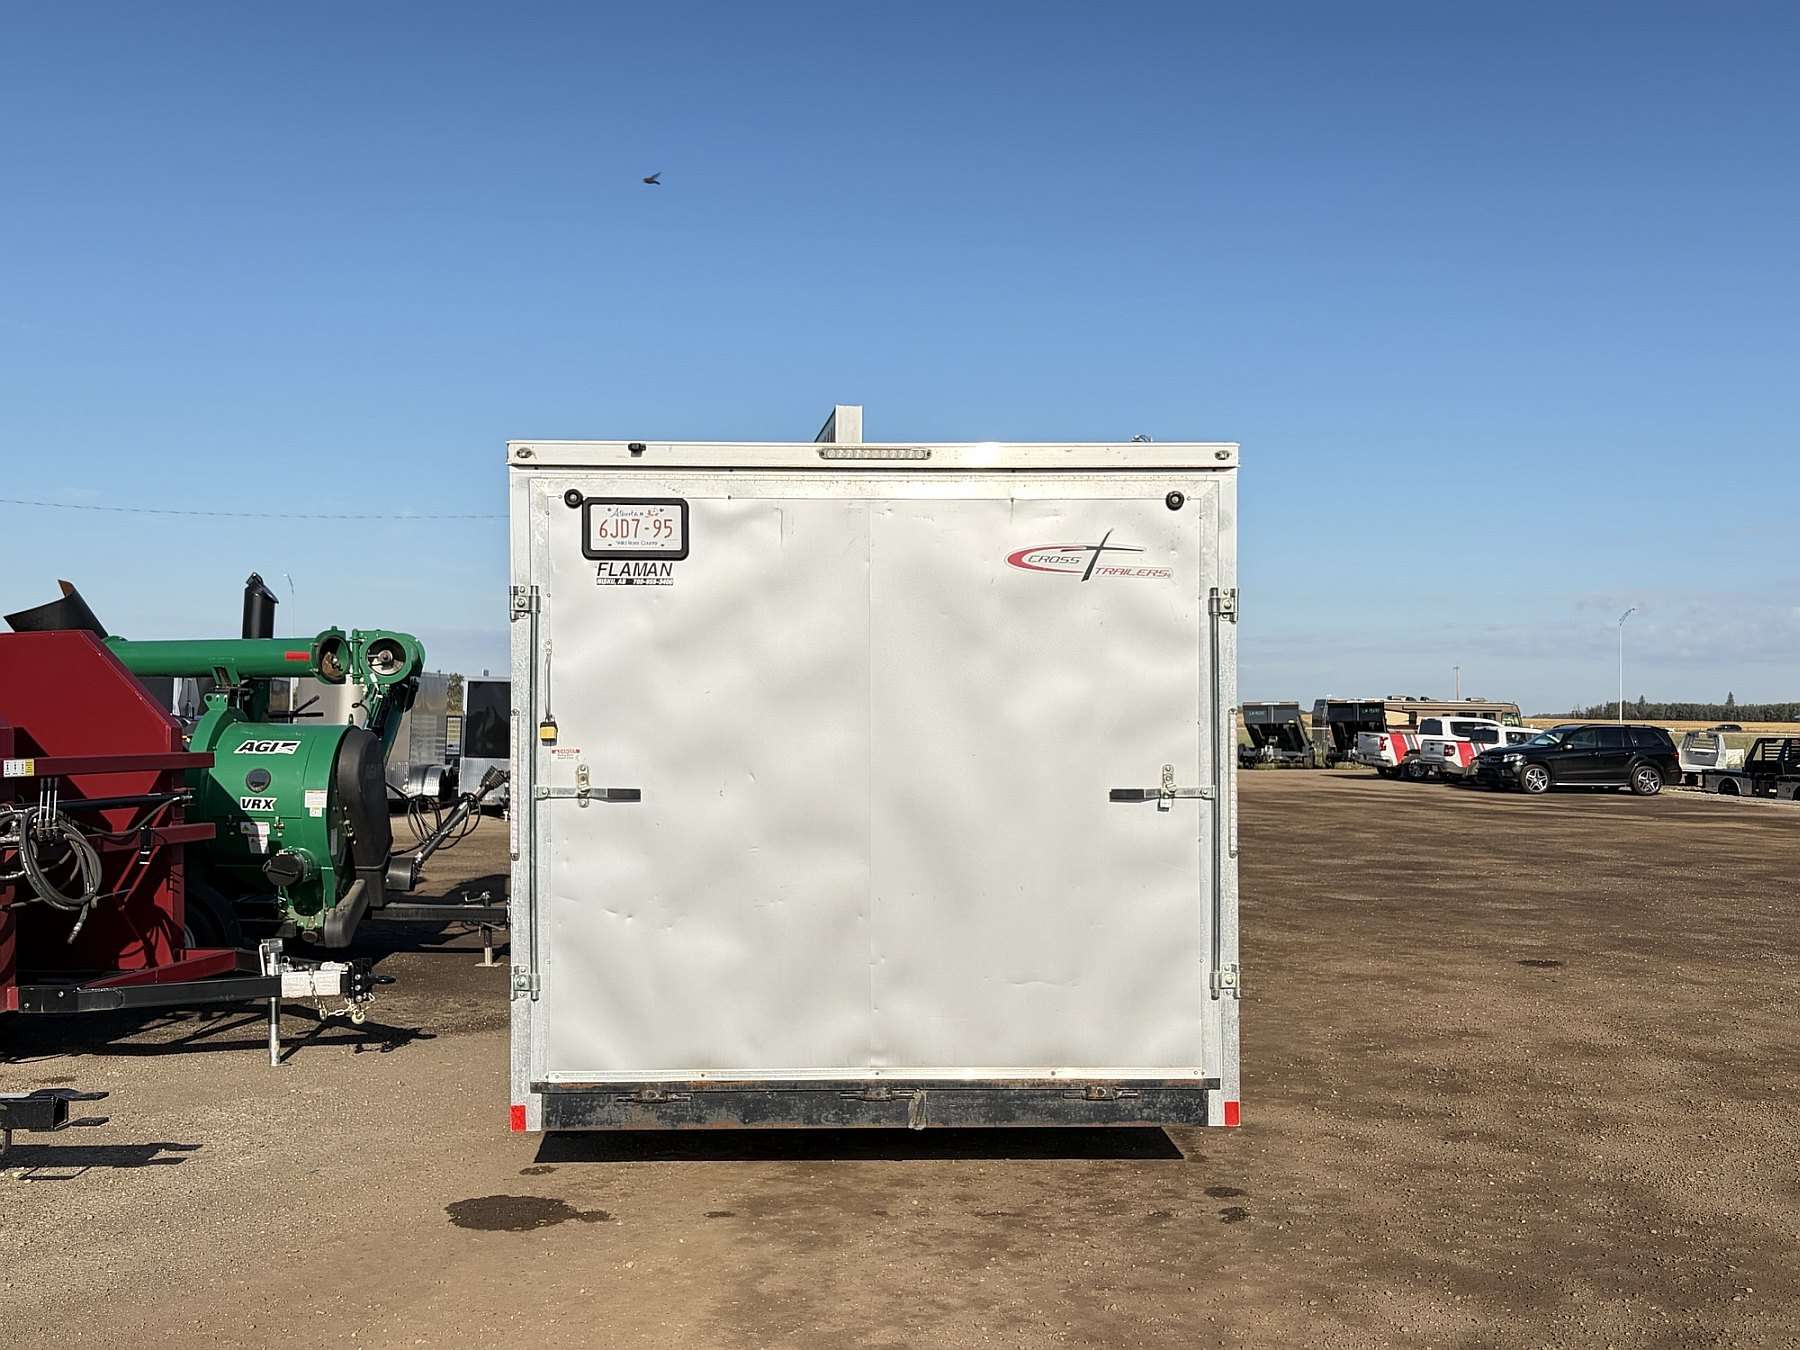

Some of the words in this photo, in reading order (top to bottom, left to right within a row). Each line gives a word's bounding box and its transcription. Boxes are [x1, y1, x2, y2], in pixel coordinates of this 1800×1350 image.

[599, 518, 673, 538] 6JD7-95
[1028, 555, 1082, 565] CROSS
[597, 562, 673, 577] FLAMAN
[1095, 567, 1169, 578] TRAILERS
[238, 741, 279, 753] AGI
[241, 798, 274, 810] VRX
